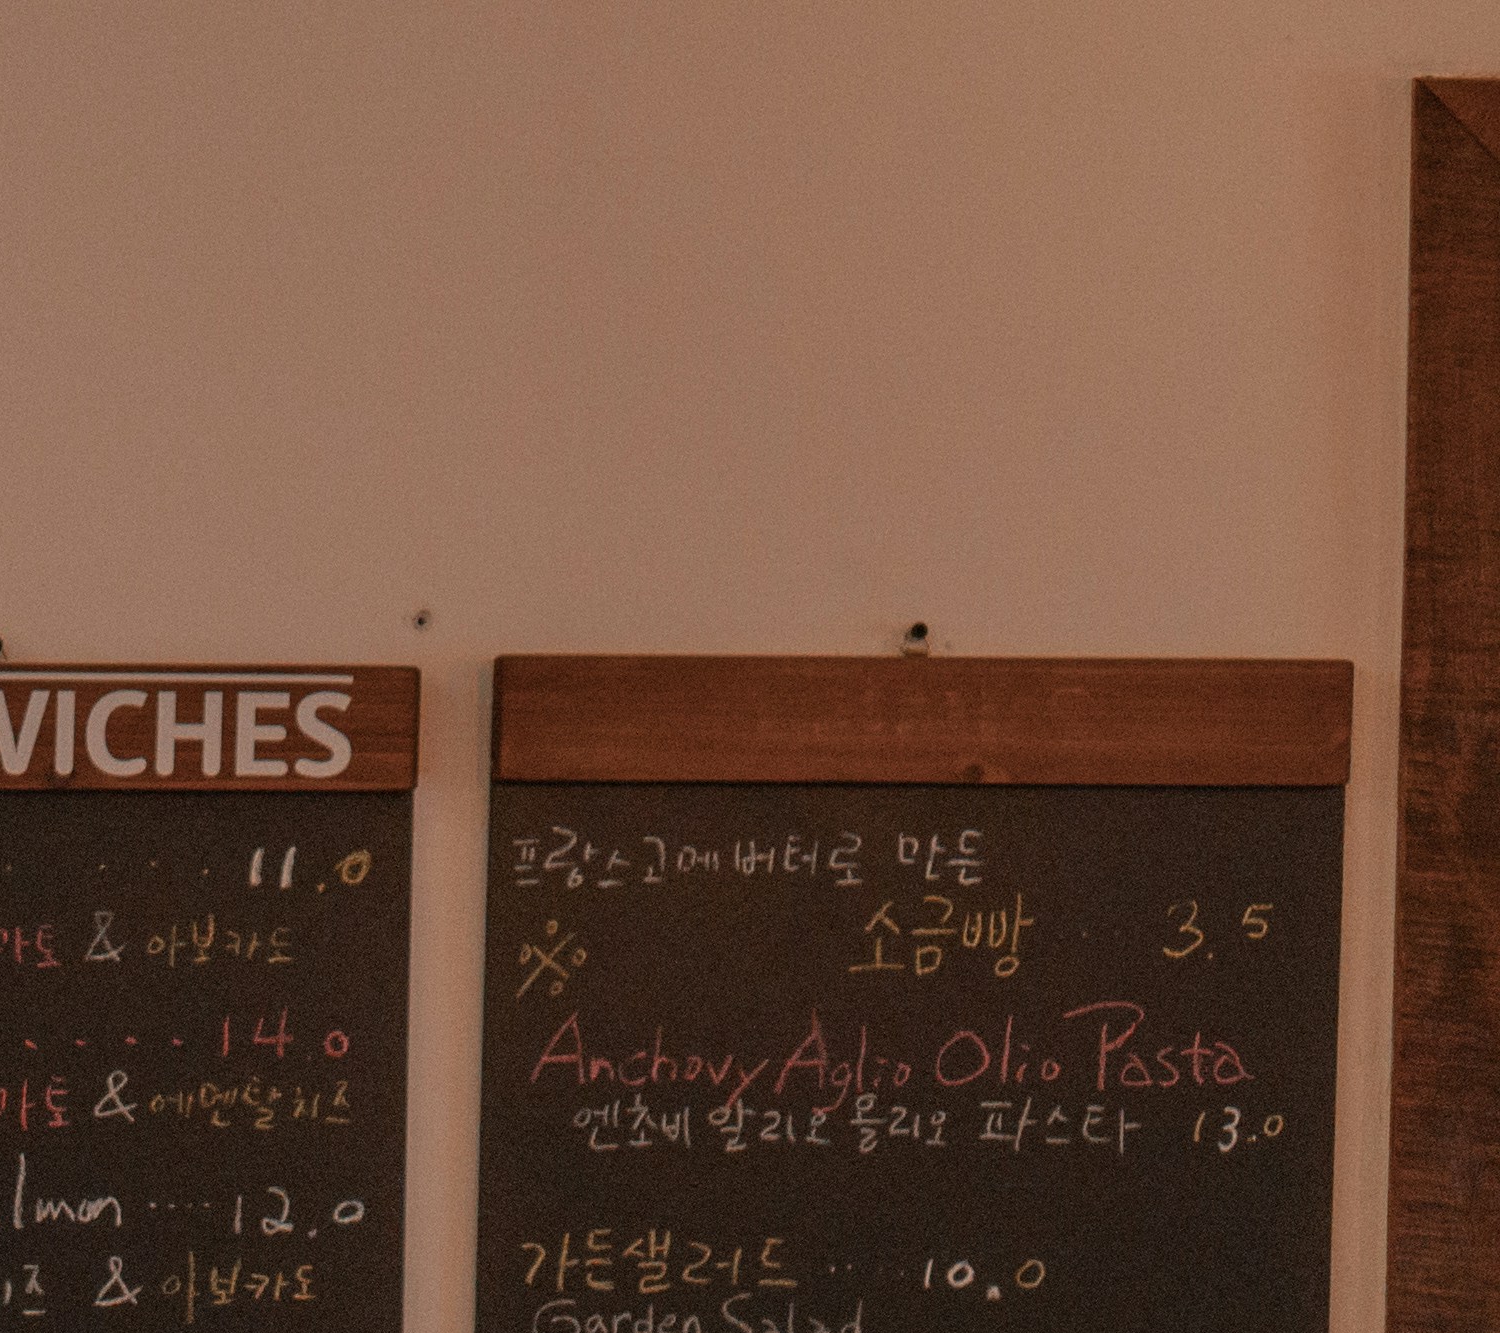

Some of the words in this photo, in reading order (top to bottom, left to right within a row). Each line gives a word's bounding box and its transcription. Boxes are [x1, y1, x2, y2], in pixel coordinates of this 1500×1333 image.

[249, 846, 371, 889] 11.0
[898, 829, 982, 886] 만든
[85, 911, 125, 962] &
[147, 913, 292, 967] 아보카도
[848, 893, 1035, 978] 소금빵
[1162, 899, 1274, 959] 3.5
[529, 1010, 768, 1108] Anchovy
[774, 1007, 911, 1115] Aglio
[935, 1014, 1060, 1086] Olio
[1062, 1000, 1255, 1091] Pasta
[93, 1070, 137, 1121] &
[573, 1093, 691, 1151] 엔초비
[708, 1099, 829, 1153] 알리오
[850, 1093, 947, 1154] 올리오
[979, 1097, 1142, 1154] 파스타
[1193, 1107, 1284, 1153] 13.0
[233, 1187, 365, 1238] 12.0
[94, 1255, 143, 1306] &
[923, 1258, 1046, 1301] 10.0
